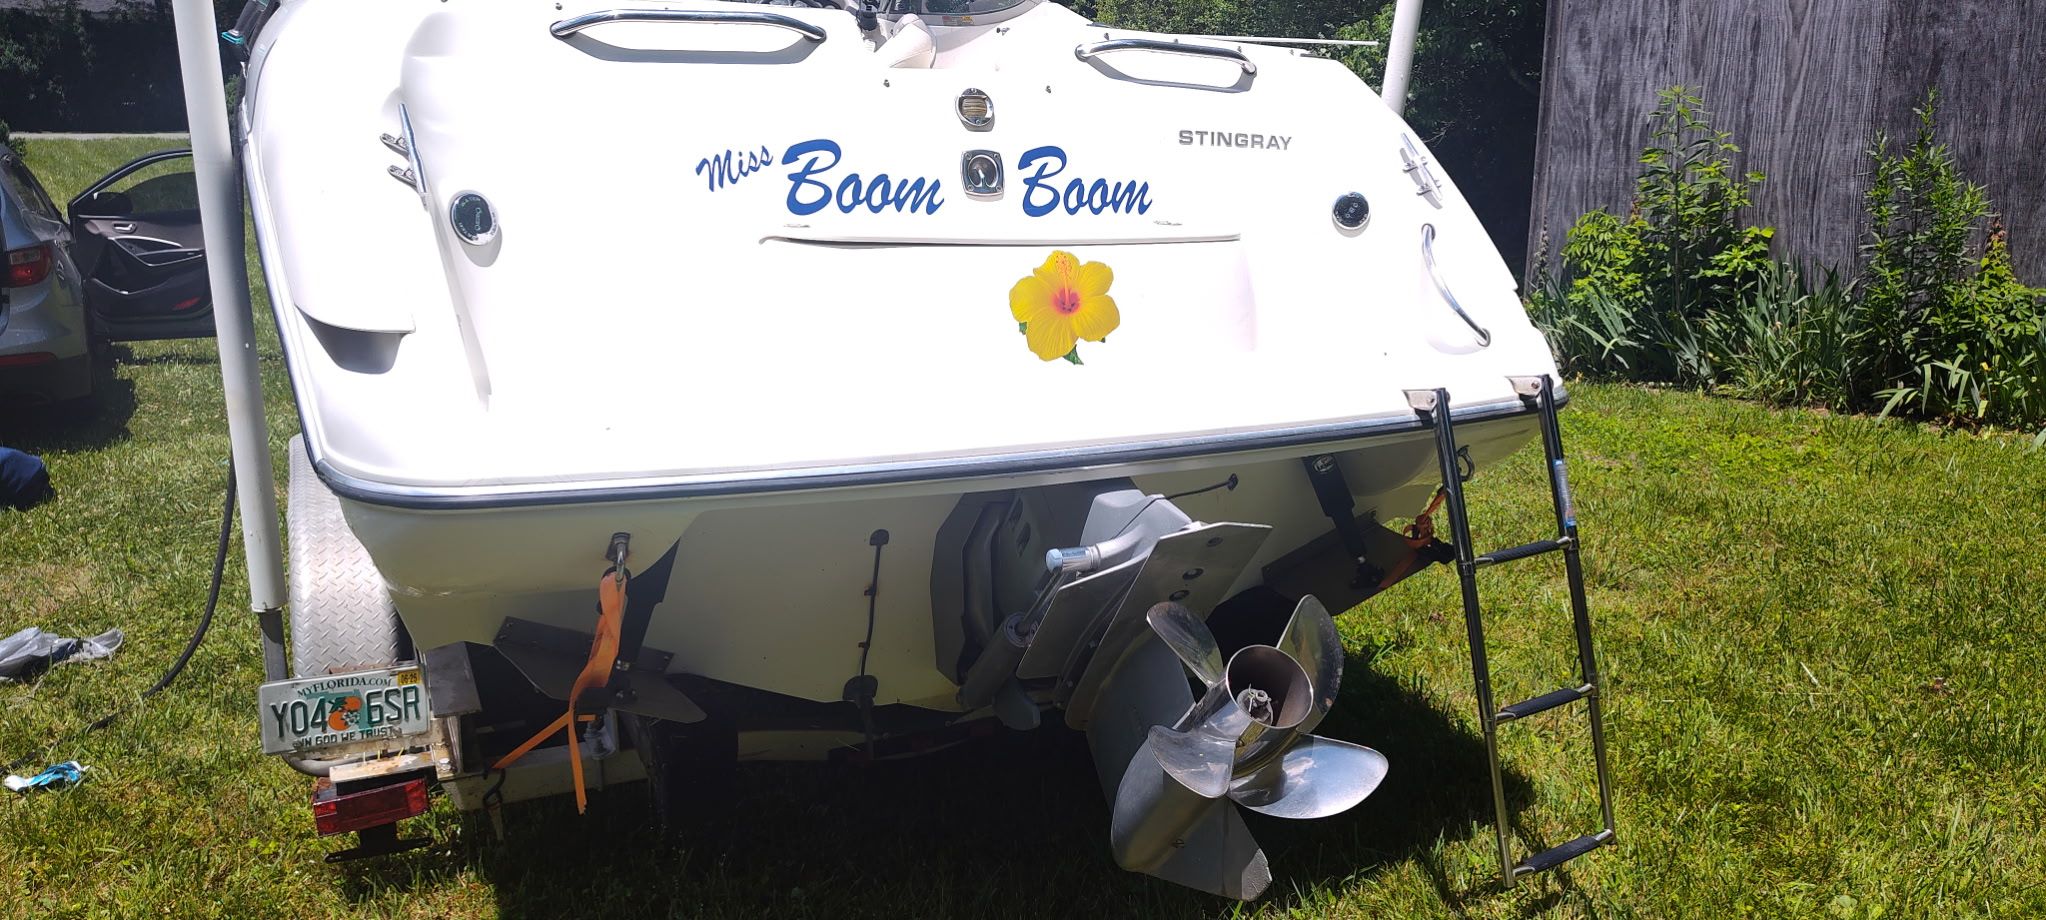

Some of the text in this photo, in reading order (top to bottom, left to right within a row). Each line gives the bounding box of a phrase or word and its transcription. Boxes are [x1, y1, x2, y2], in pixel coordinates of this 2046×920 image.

[1178, 130, 1292, 150] STINGRAY
[695, 138, 1152, 217] Miss Boom Boom
[315, 734, 338, 746] GOD
[341, 731, 356, 741] WE
[359, 726, 394, 740] TRUST
